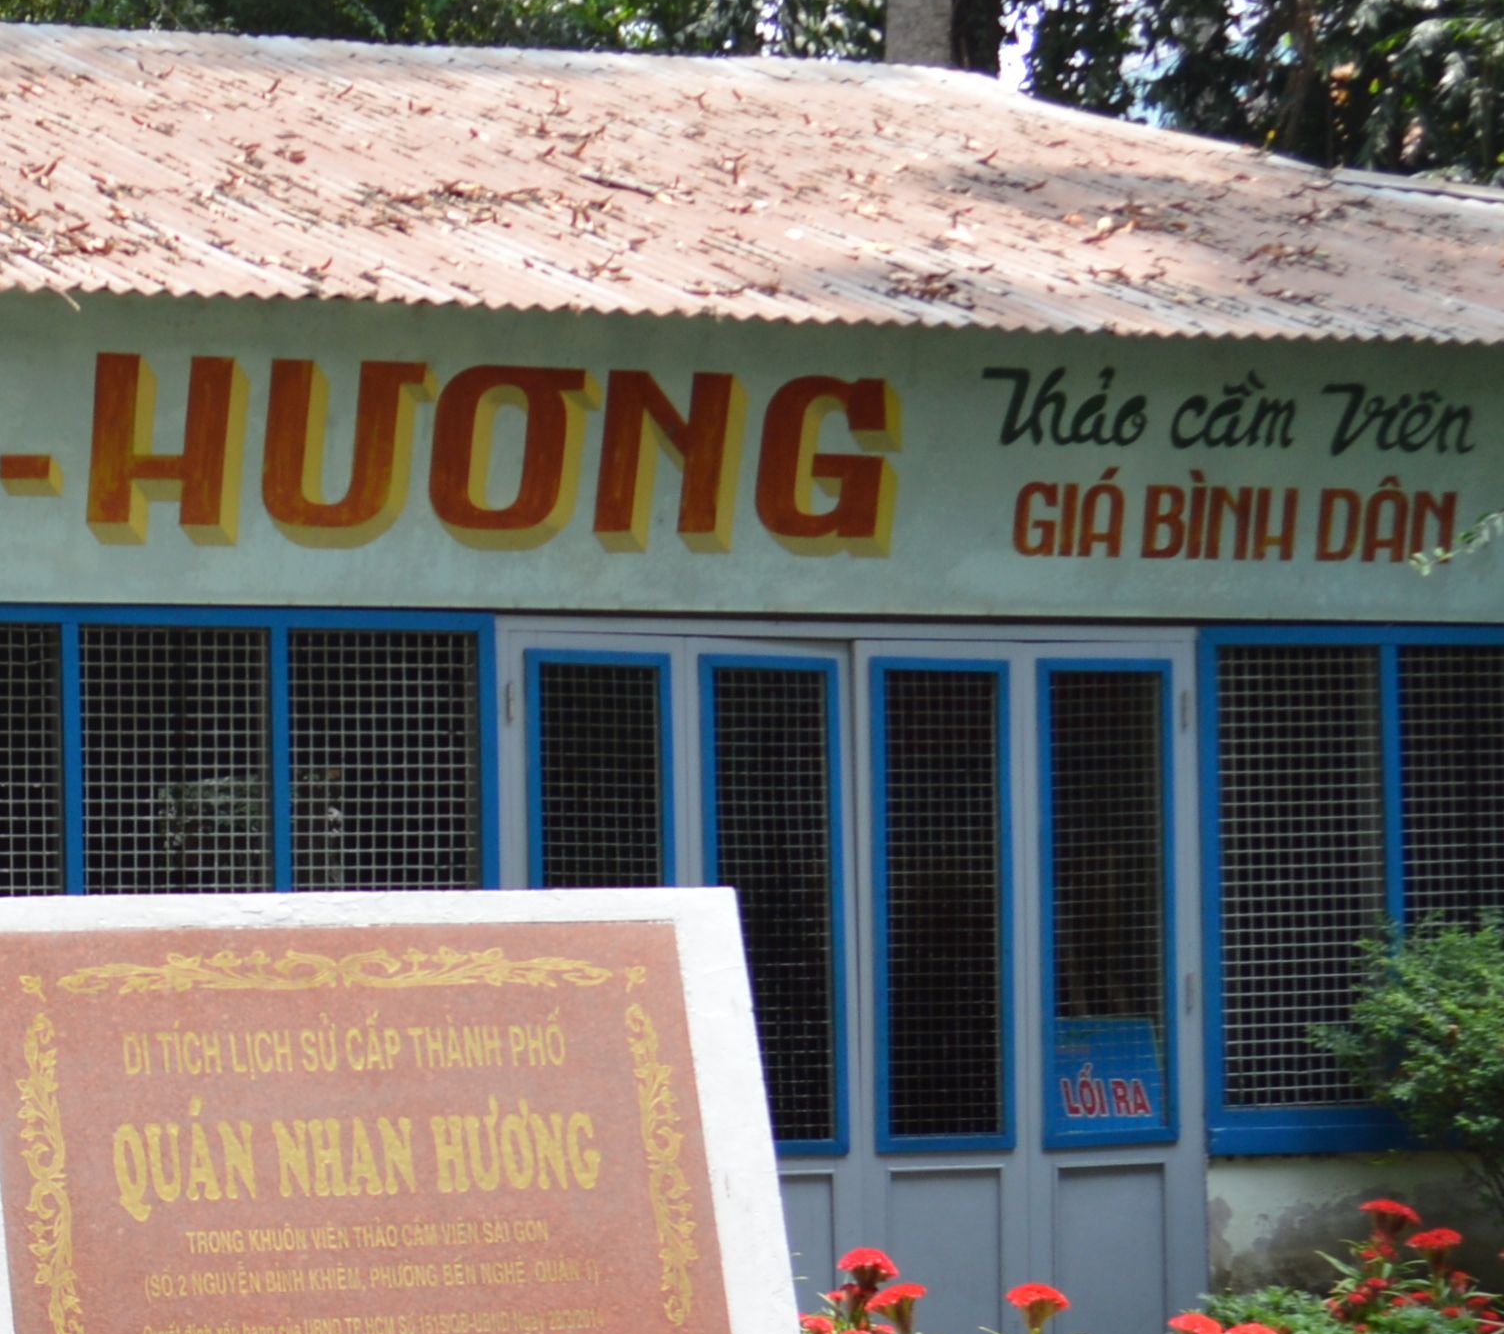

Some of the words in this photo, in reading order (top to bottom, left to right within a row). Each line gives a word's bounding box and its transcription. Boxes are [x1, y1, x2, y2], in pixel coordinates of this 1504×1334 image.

[1169, 369, 1296, 450] cầm
[1012, 467, 1125, 558] GIÁ
[1140, 470, 1299, 562] BÌNH
[1314, 475, 1458, 564] DÂN
[122, 1032, 151, 1075] DI
[157, 1020, 222, 1074] TÍCH
[230, 1029, 293, 1080] LỊCH
[300, 1012, 338, 1072] SỬ
[345, 1009, 402, 1071] CẤP
[407, 1014, 503, 1070] THÀNH
[510, 1006, 567, 1067] PHỐ
[1060, 1062, 1109, 1118] LỐI
[1109, 1078, 1153, 1117] RA
[113, 1098, 256, 1222] QUÁN
[272, 1117, 417, 1197] NHAN
[430, 1094, 601, 1194] HƯƠNG
[185, 1229, 245, 1255] TRONG
[249, 1222, 307, 1252] KHUÔN
[311, 1221, 350, 1250] VIÊN
[177, 1274, 189, 1297] 2
